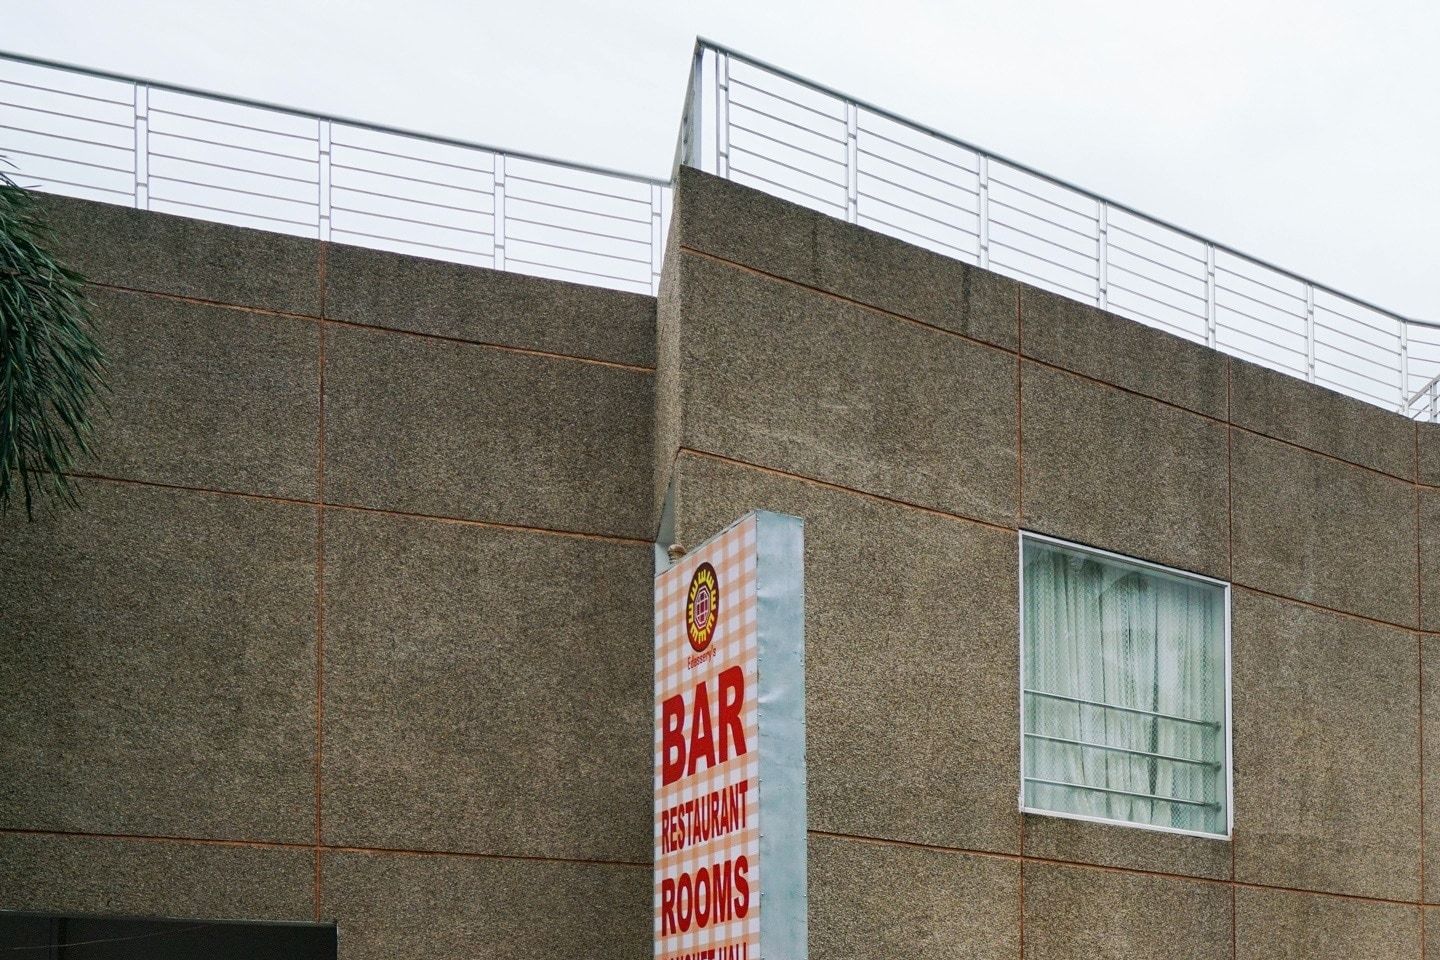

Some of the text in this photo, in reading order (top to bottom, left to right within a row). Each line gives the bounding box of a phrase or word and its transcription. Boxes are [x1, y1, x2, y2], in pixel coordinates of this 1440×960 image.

[662, 665, 747, 787] BAR
[661, 780, 748, 854] RESTAURANT
[661, 855, 749, 937] ROOMS
